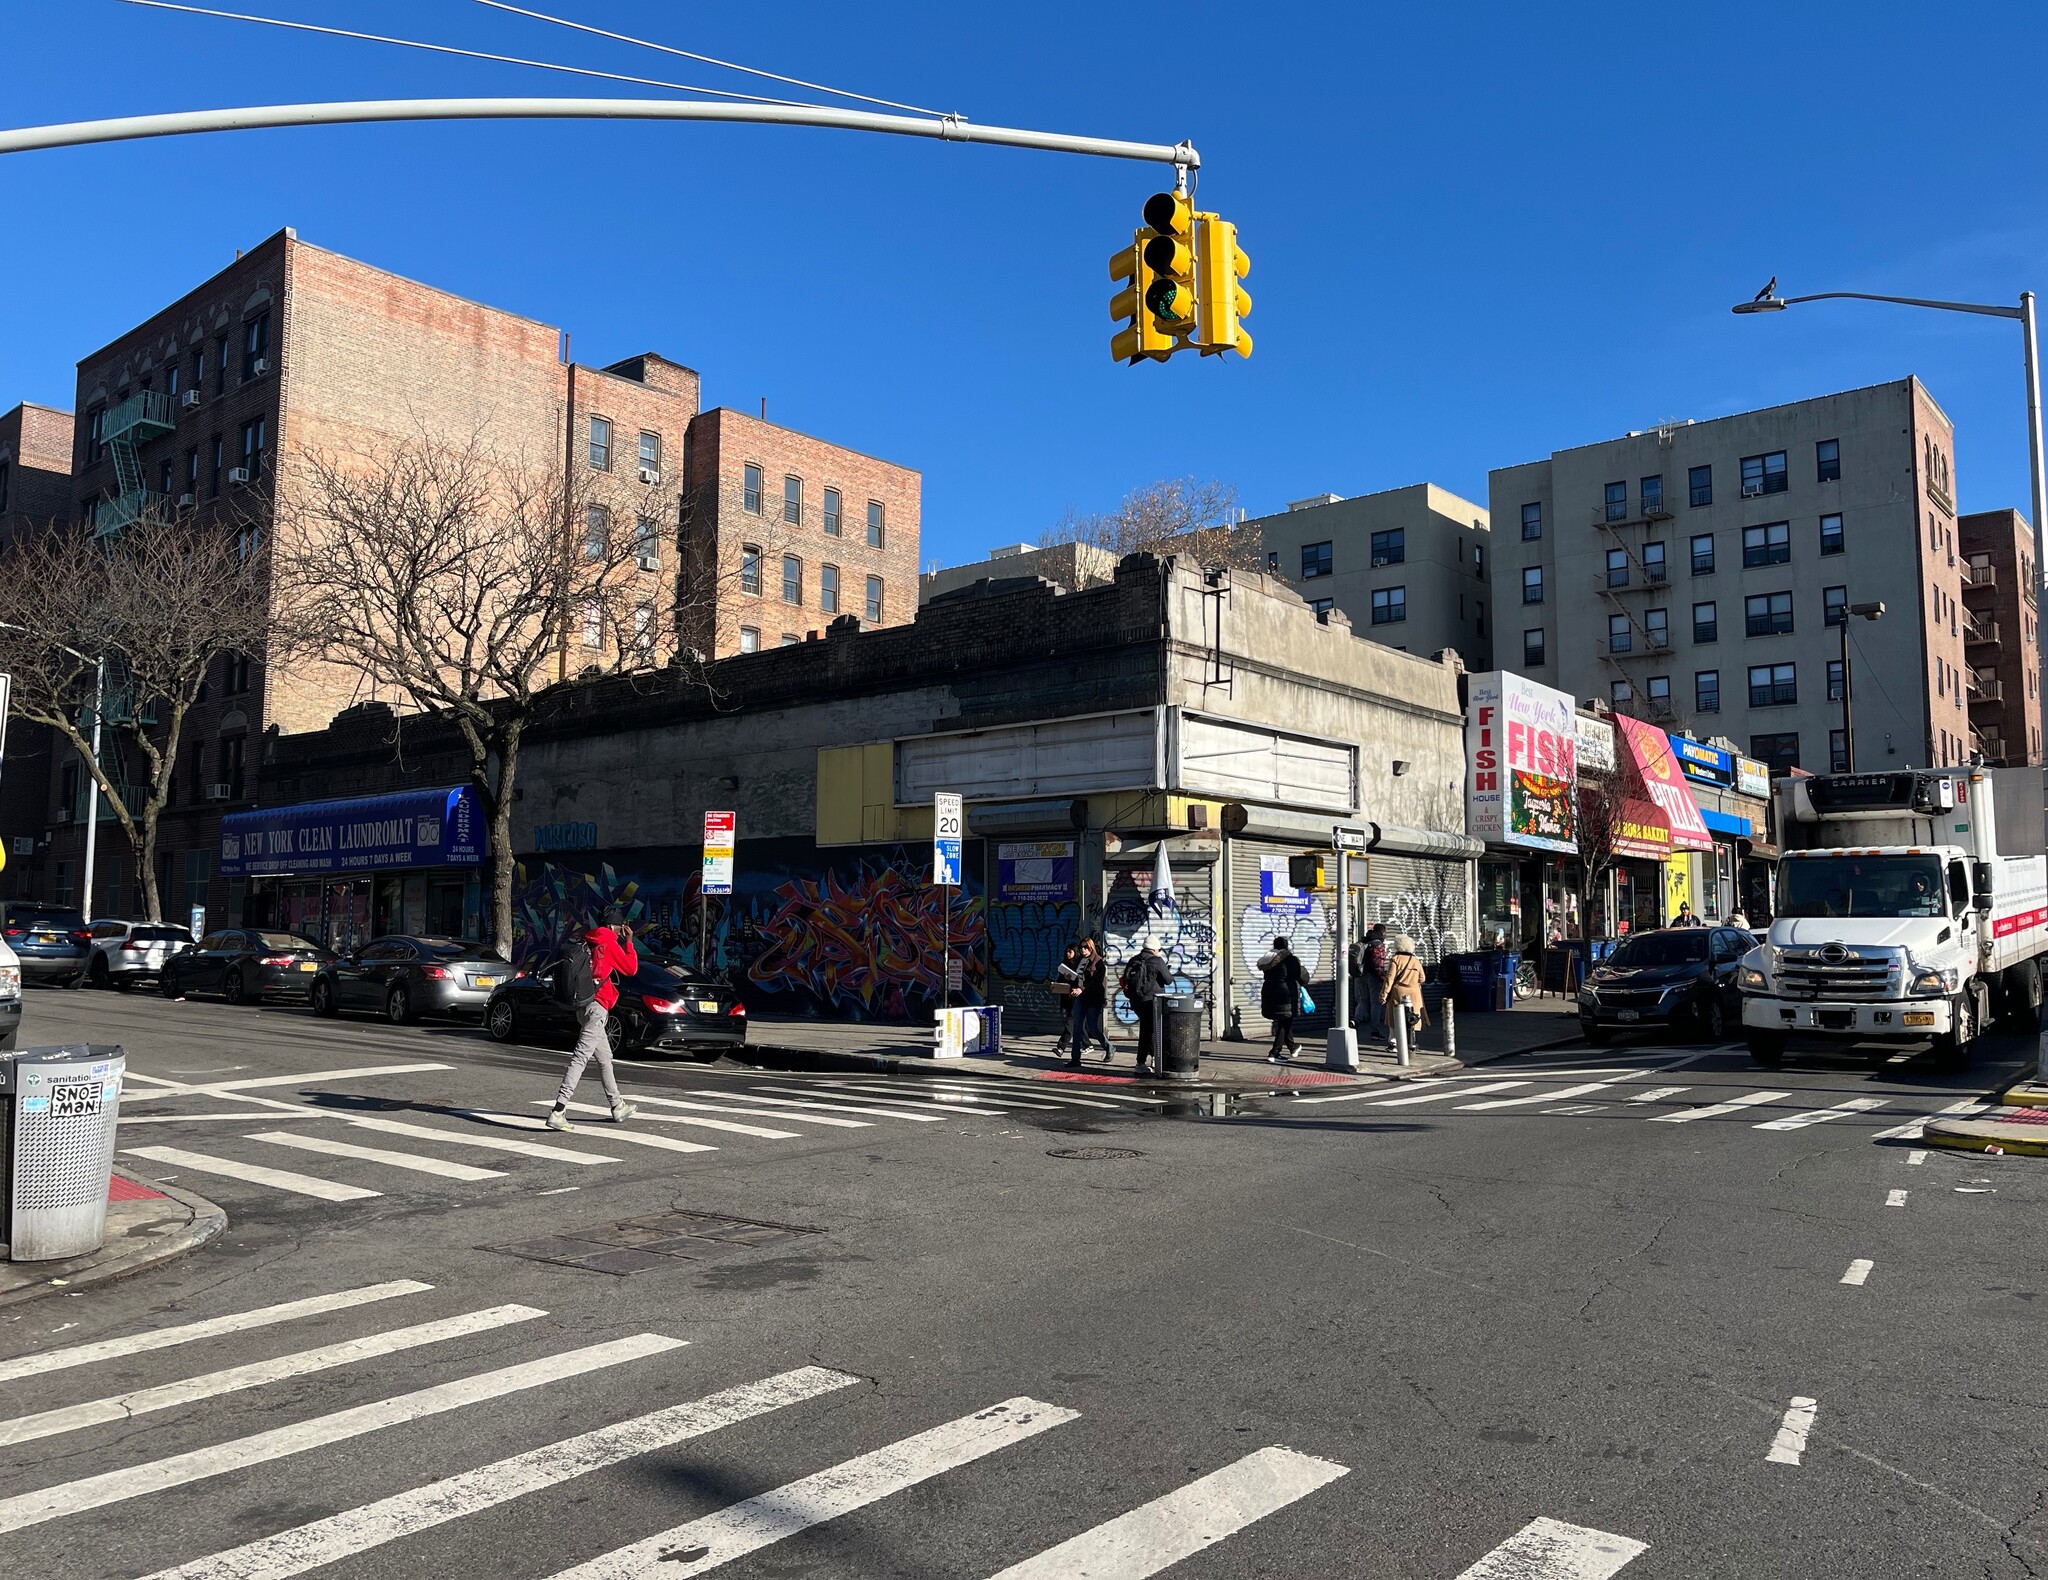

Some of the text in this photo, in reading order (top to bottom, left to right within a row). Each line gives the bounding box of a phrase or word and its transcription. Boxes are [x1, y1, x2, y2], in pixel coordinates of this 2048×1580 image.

[1521, 684, 1534, 697] Best
[1508, 693, 1557, 724] New York
[1476, 706, 1496, 791] FISH
[1508, 720, 1574, 779] FISH
[1683, 744, 1719, 765] PAYOMATIC
[1832, 778, 1887, 787] CARRIER
[939, 798, 959, 806] SPEED
[1646, 779, 1708, 834] PIZZA
[940, 817, 958, 833] 20
[1475, 814, 1498, 824] CRISPY
[1472, 824, 1501, 832] CHICKEN
[1643, 825, 1668, 843] BAKERY
[244, 818, 413, 856] NEW YORK CLEAN LAUNDROMAT
[341, 857, 348, 867] 24
[349, 855, 368, 866] HOURS
[373, 854, 389, 864] DAYS
[394, 852, 412, 862] WEEK
[47, 1074, 90, 1083] sanitatio
